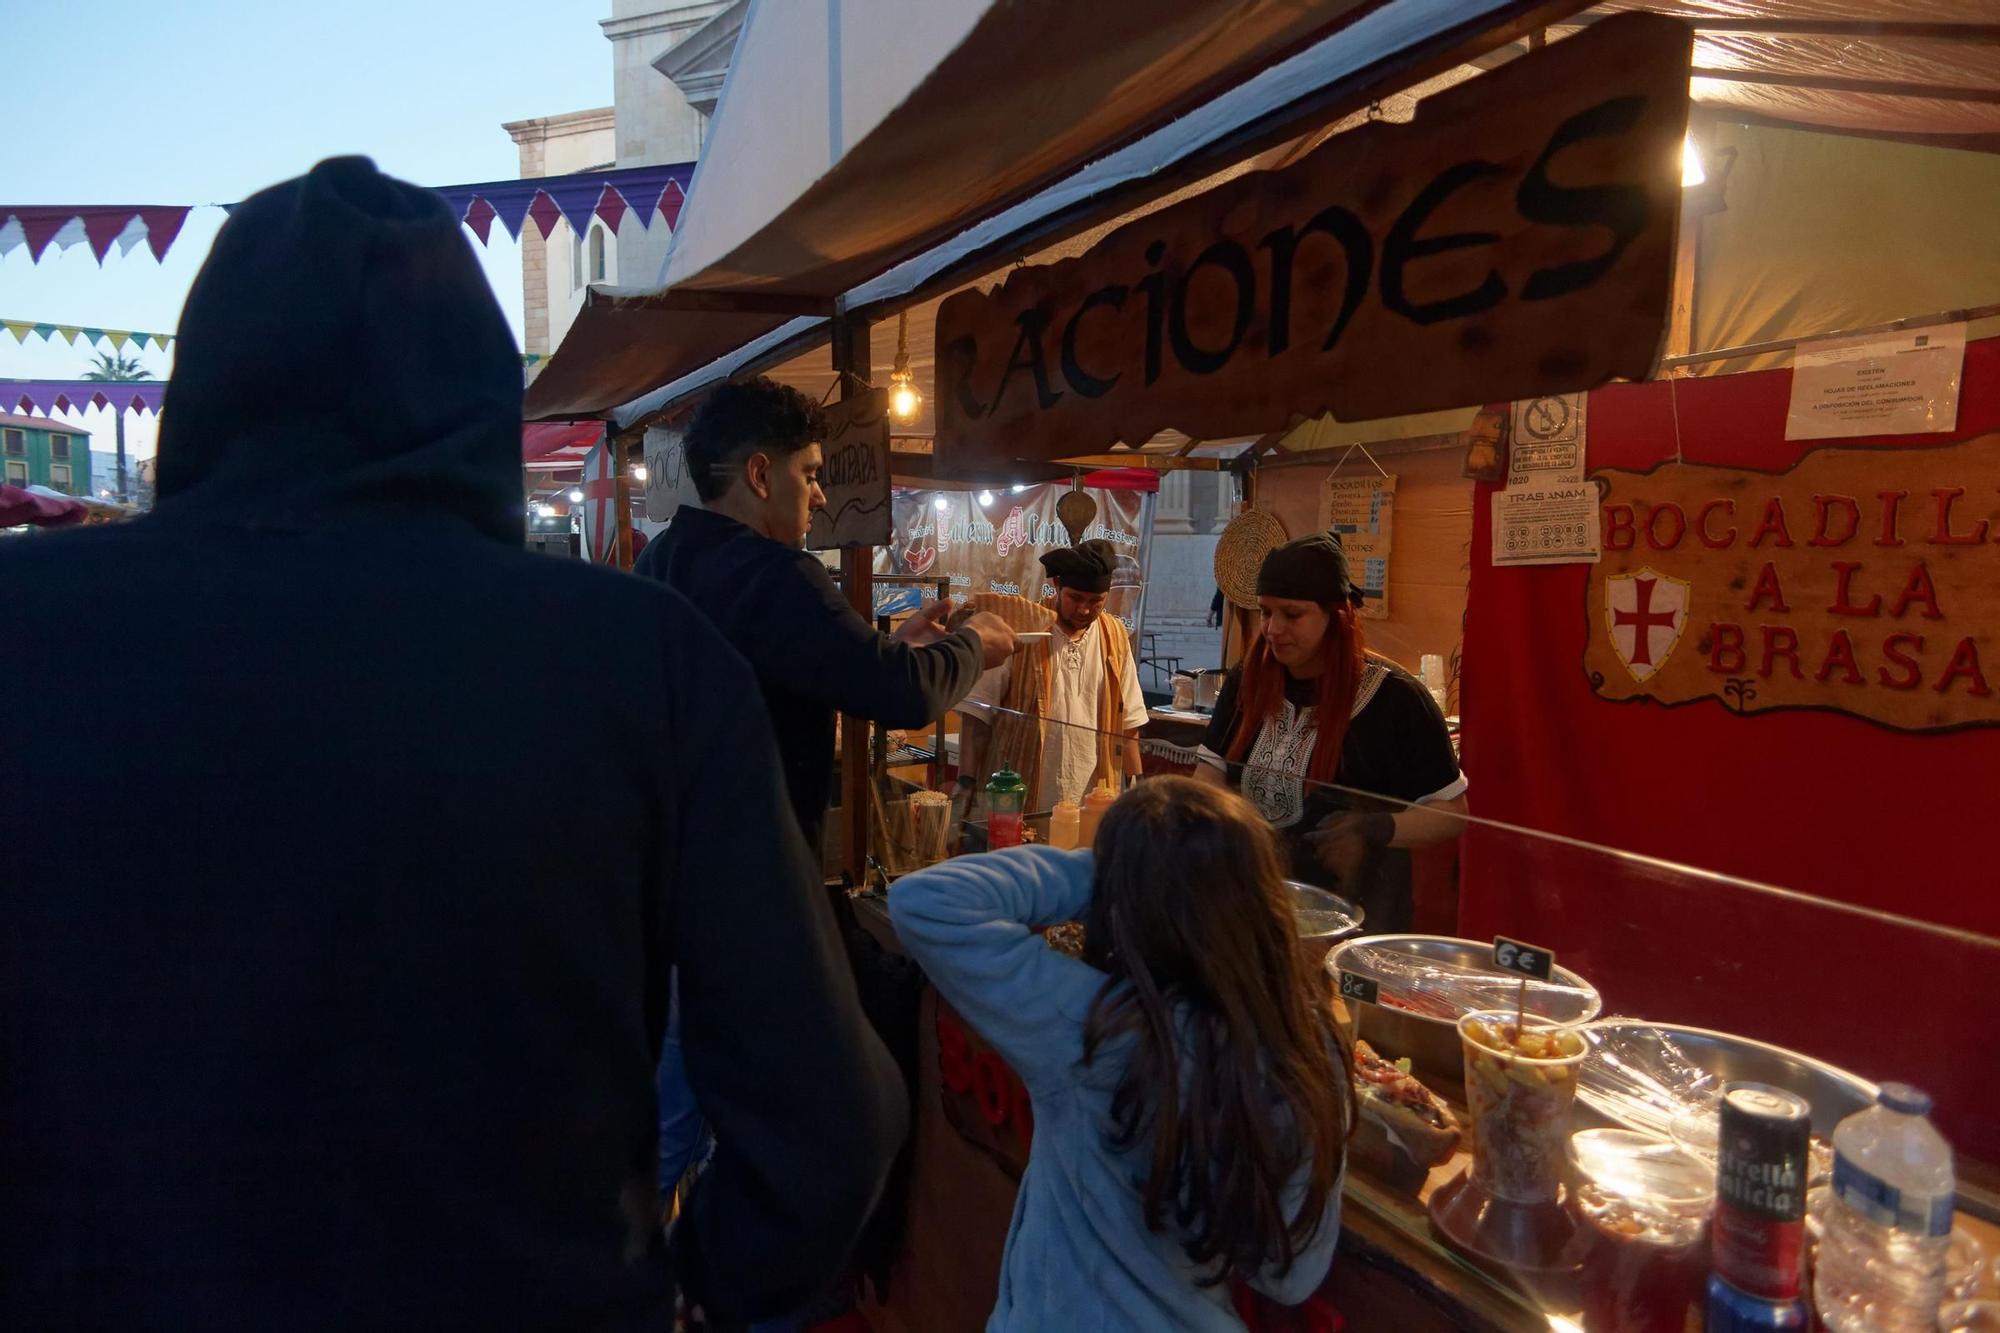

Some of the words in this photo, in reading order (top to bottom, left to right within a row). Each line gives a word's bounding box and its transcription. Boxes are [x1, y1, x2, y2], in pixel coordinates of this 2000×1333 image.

[1602, 487, 2000, 552] BOCADIL
[1745, 562, 1792, 615] A
[1826, 560, 1944, 620] LA
[1706, 622, 1992, 698] BRASA
[1342, 974, 1364, 996] 8€
